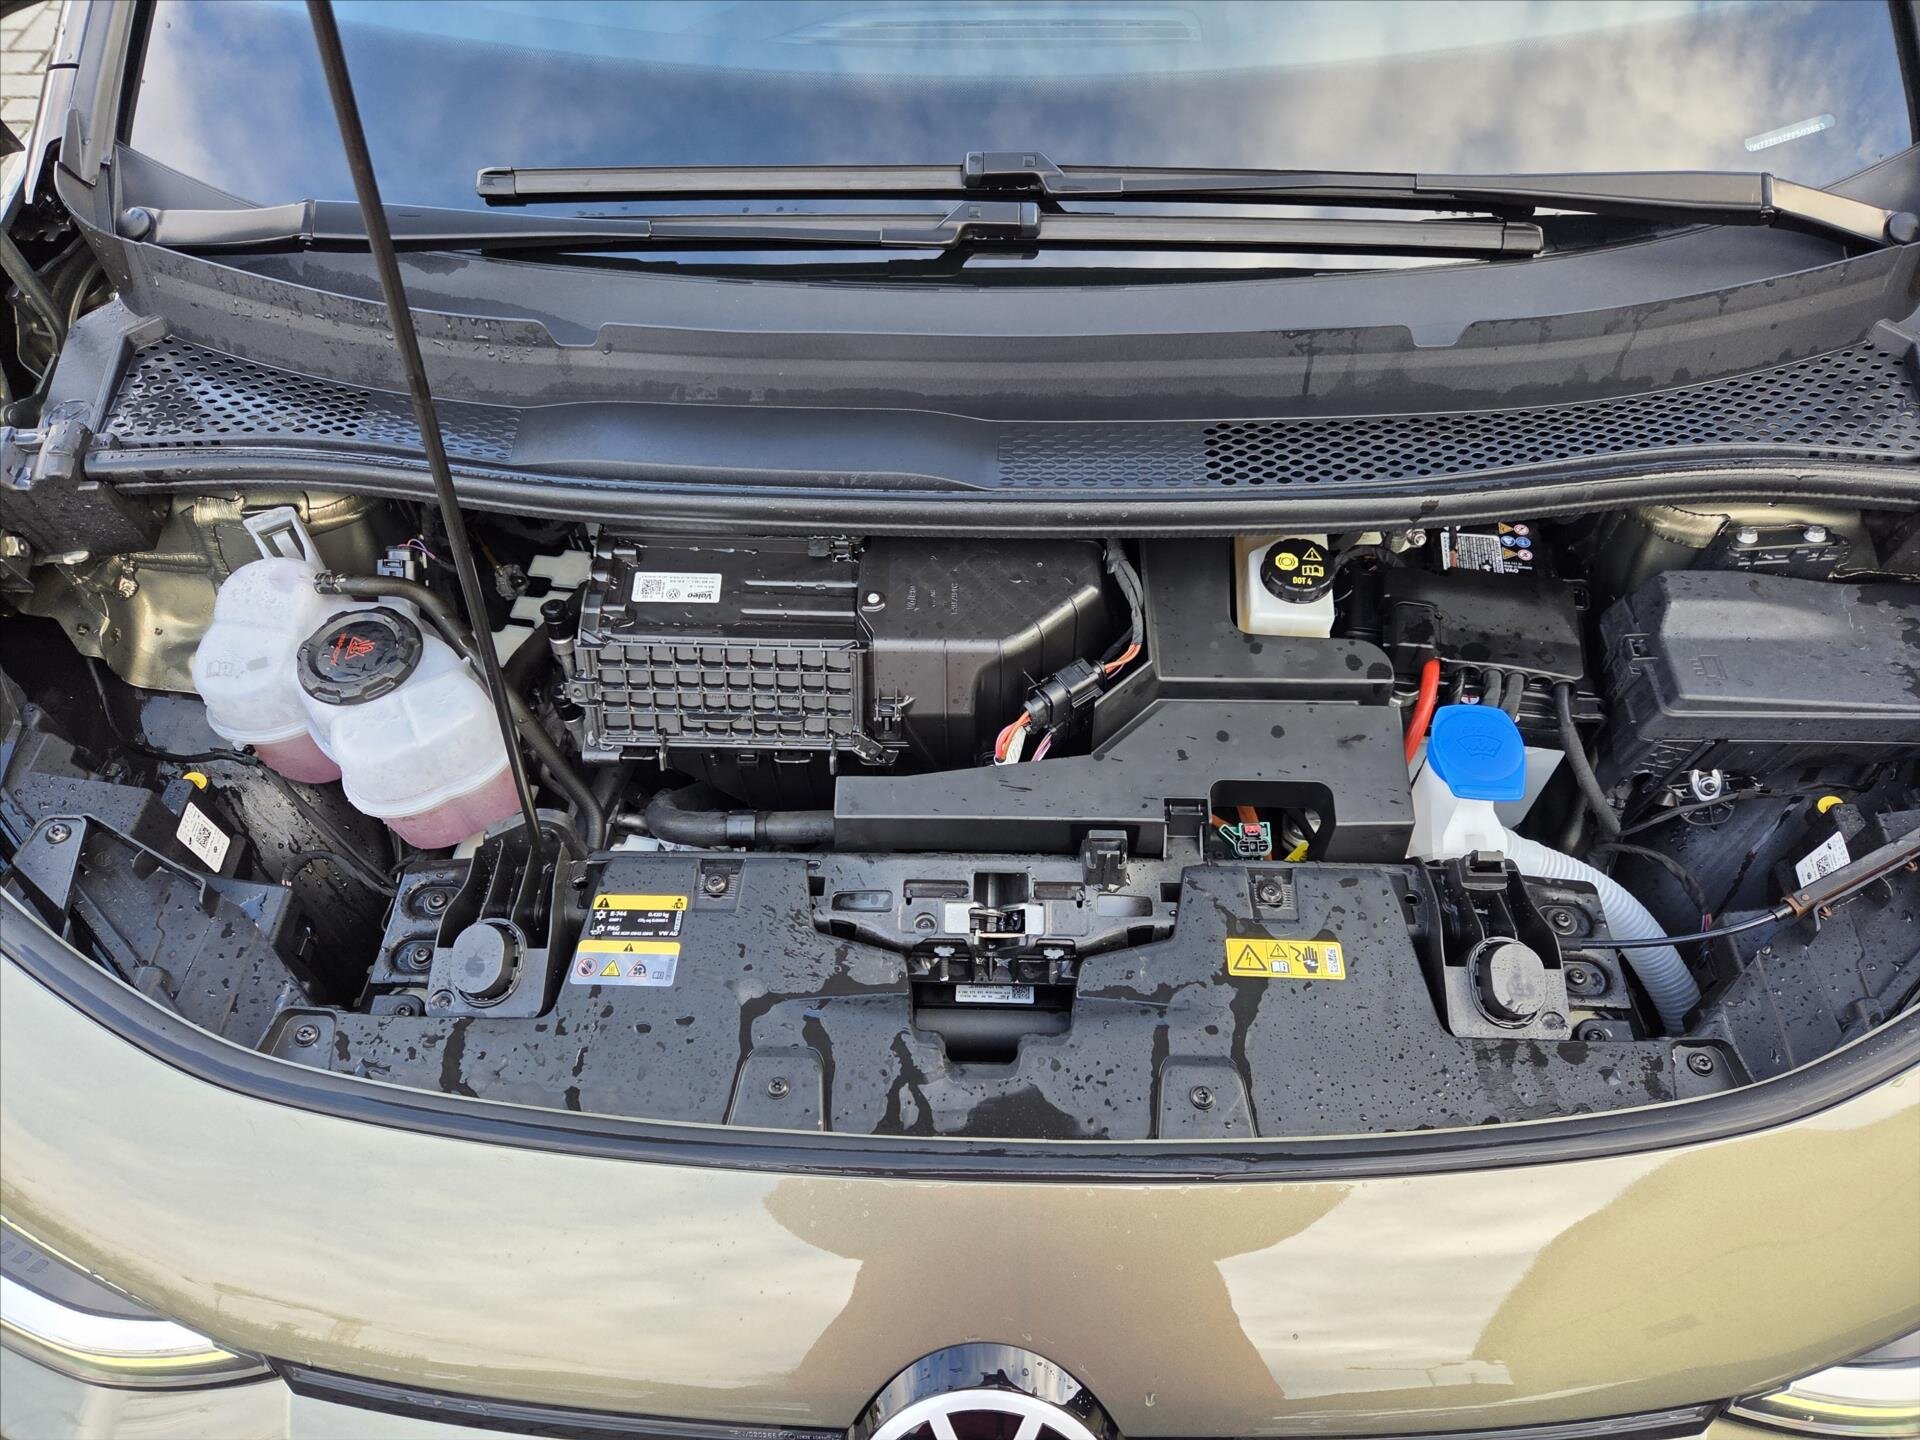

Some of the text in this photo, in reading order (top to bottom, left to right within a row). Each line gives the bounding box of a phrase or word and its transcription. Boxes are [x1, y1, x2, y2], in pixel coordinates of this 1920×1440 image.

[1292, 576, 1312, 586] DOT 4
[686, 592, 713, 600] Valeo
